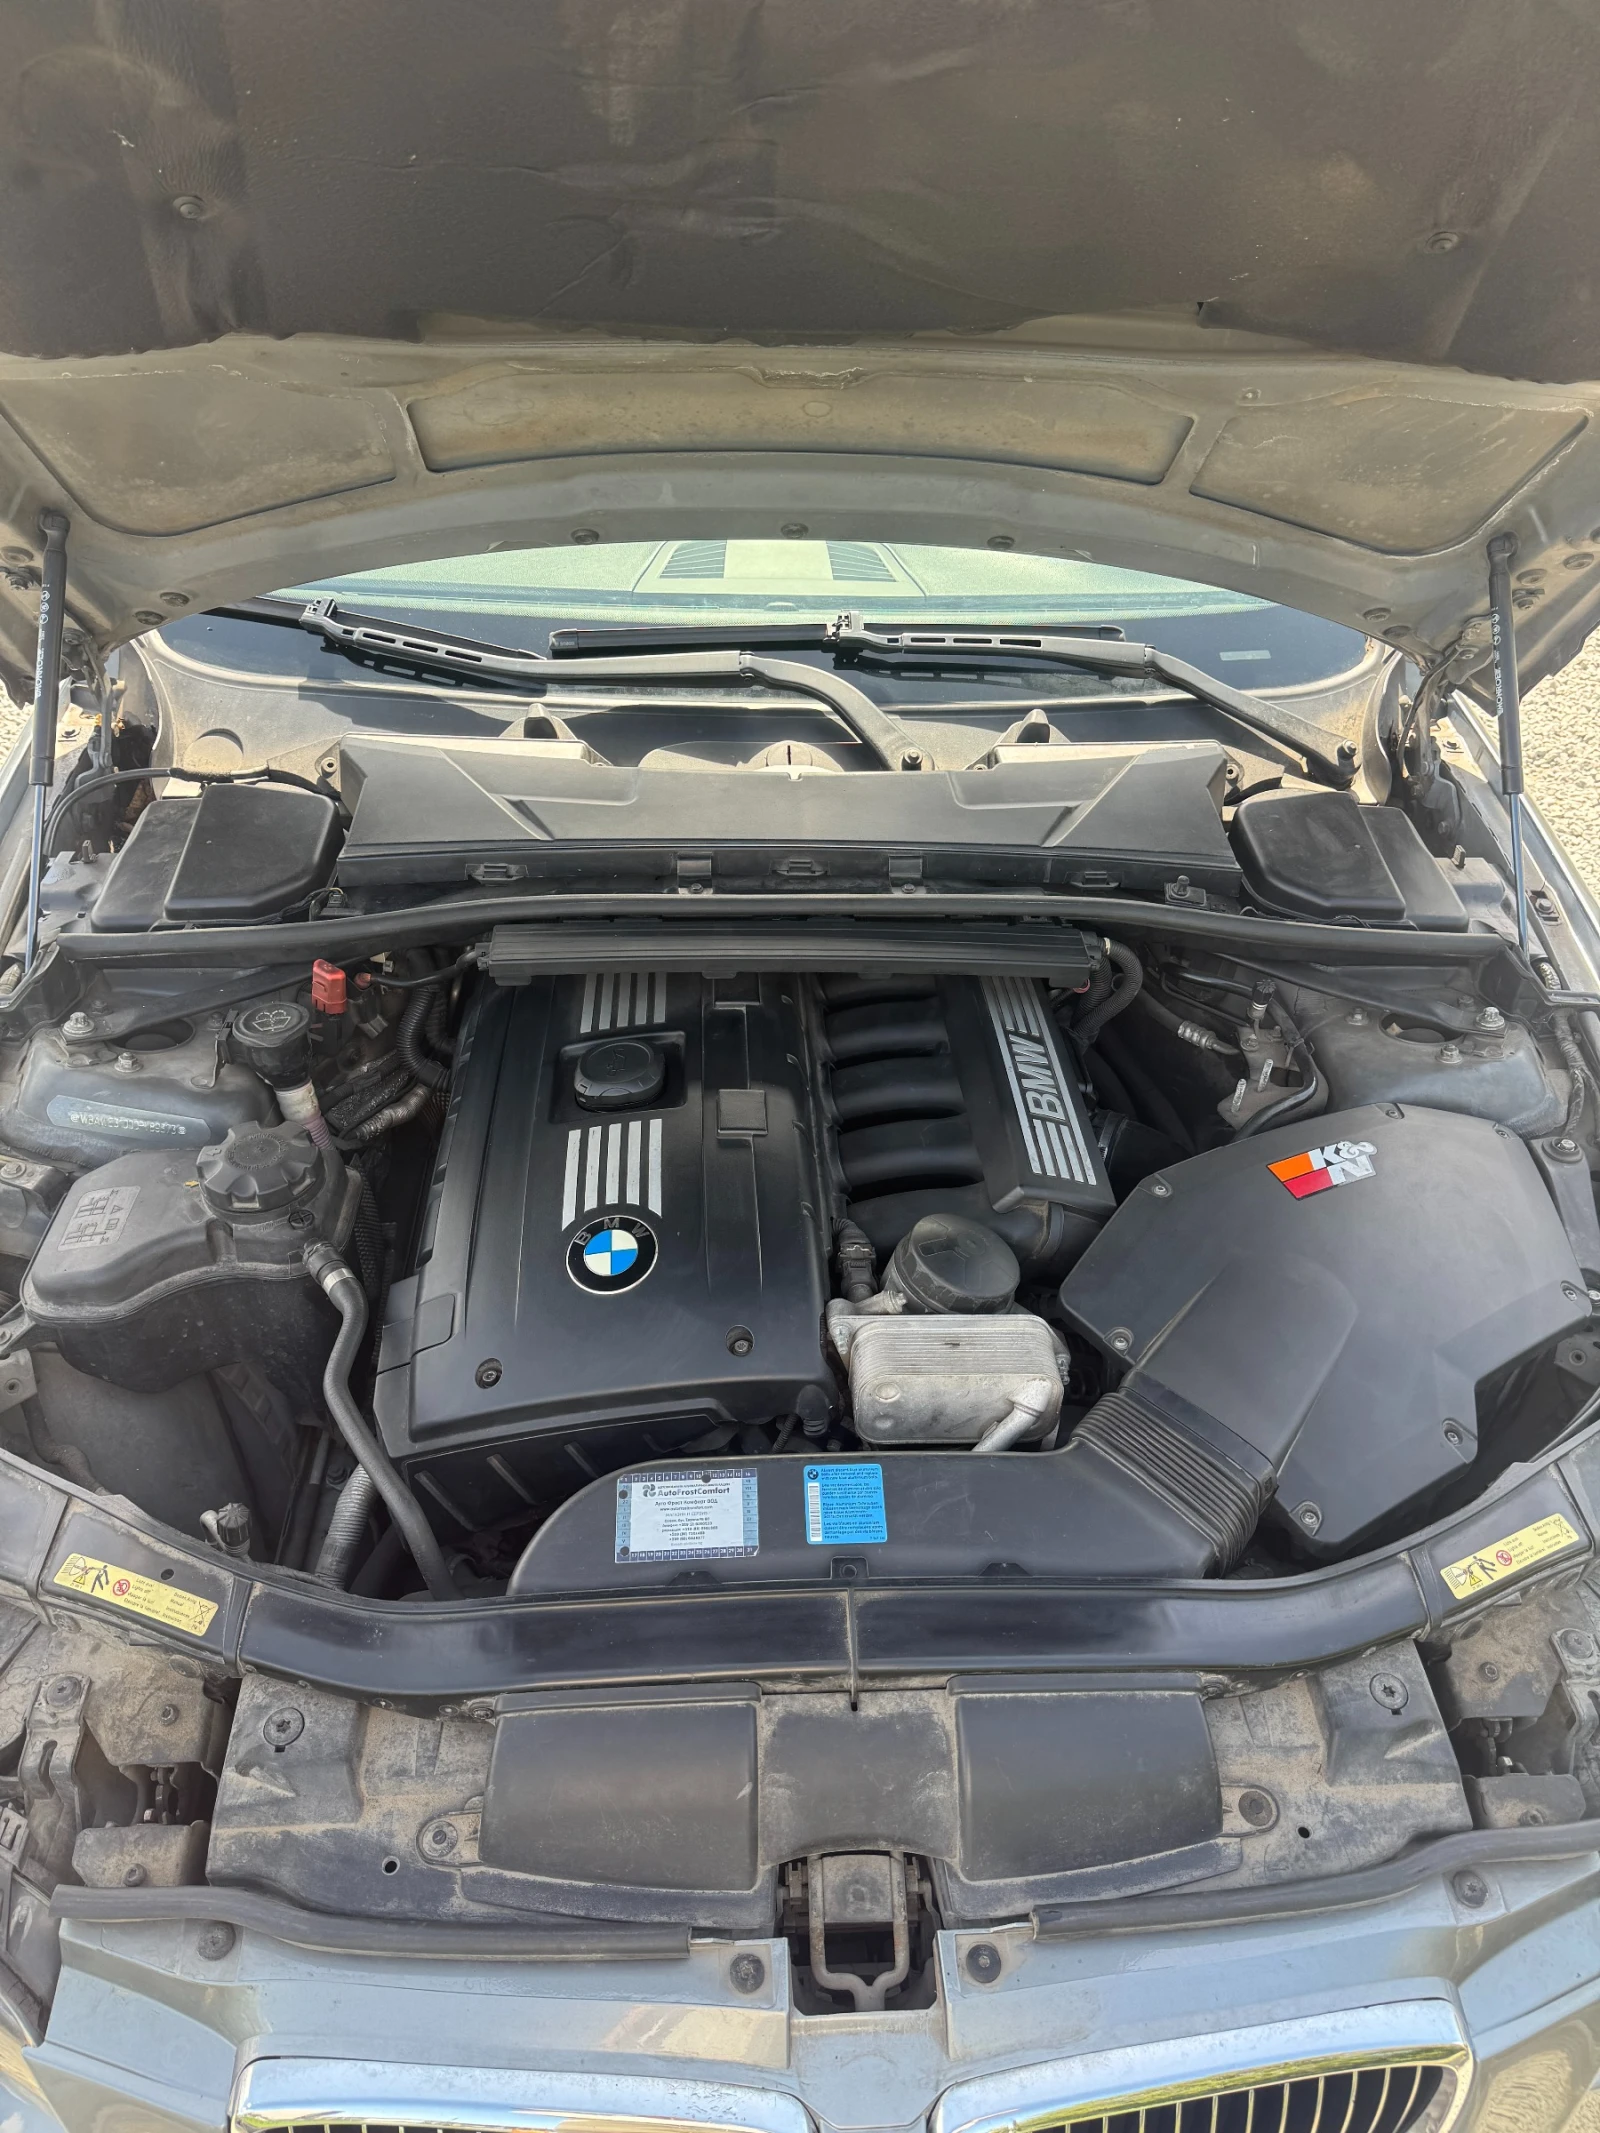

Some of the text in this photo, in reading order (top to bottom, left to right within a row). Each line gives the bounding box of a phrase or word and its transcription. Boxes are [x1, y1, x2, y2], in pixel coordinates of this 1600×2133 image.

[1008, 1033, 1067, 1120] BMW
[574, 1217, 650, 1246] BMW
[658, 1487, 730, 1497] AutoFrostComfort
